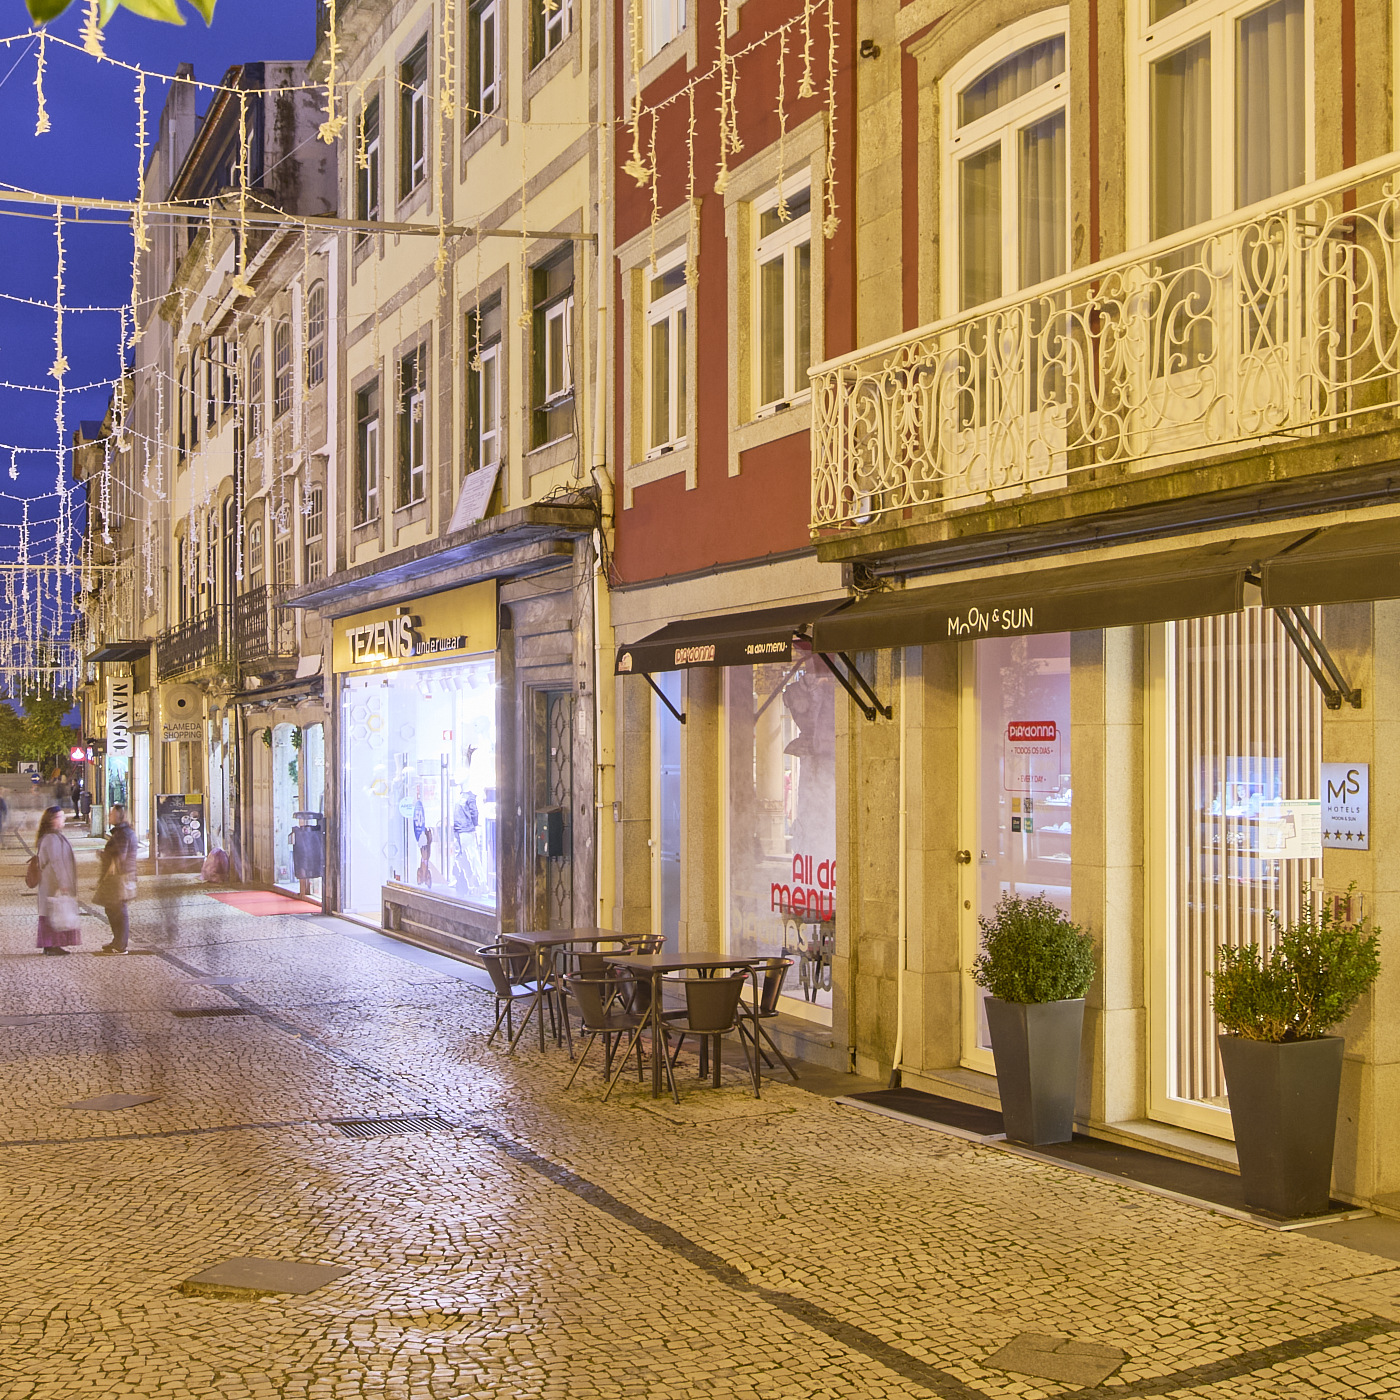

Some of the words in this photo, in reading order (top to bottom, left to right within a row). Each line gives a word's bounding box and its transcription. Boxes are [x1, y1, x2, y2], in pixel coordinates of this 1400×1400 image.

[947, 607, 989, 636] MOON
[992, 608, 1000, 622] &
[1001, 607, 1034, 630] SUN
[416, 635, 461, 655] underwear
[113, 683, 129, 750] MANGO
[163, 722, 202, 731] ALAMEDA
[163, 731, 202, 739] SHOPPING
[1327, 769, 1360, 804] MS
[770, 882, 833, 921] menu
